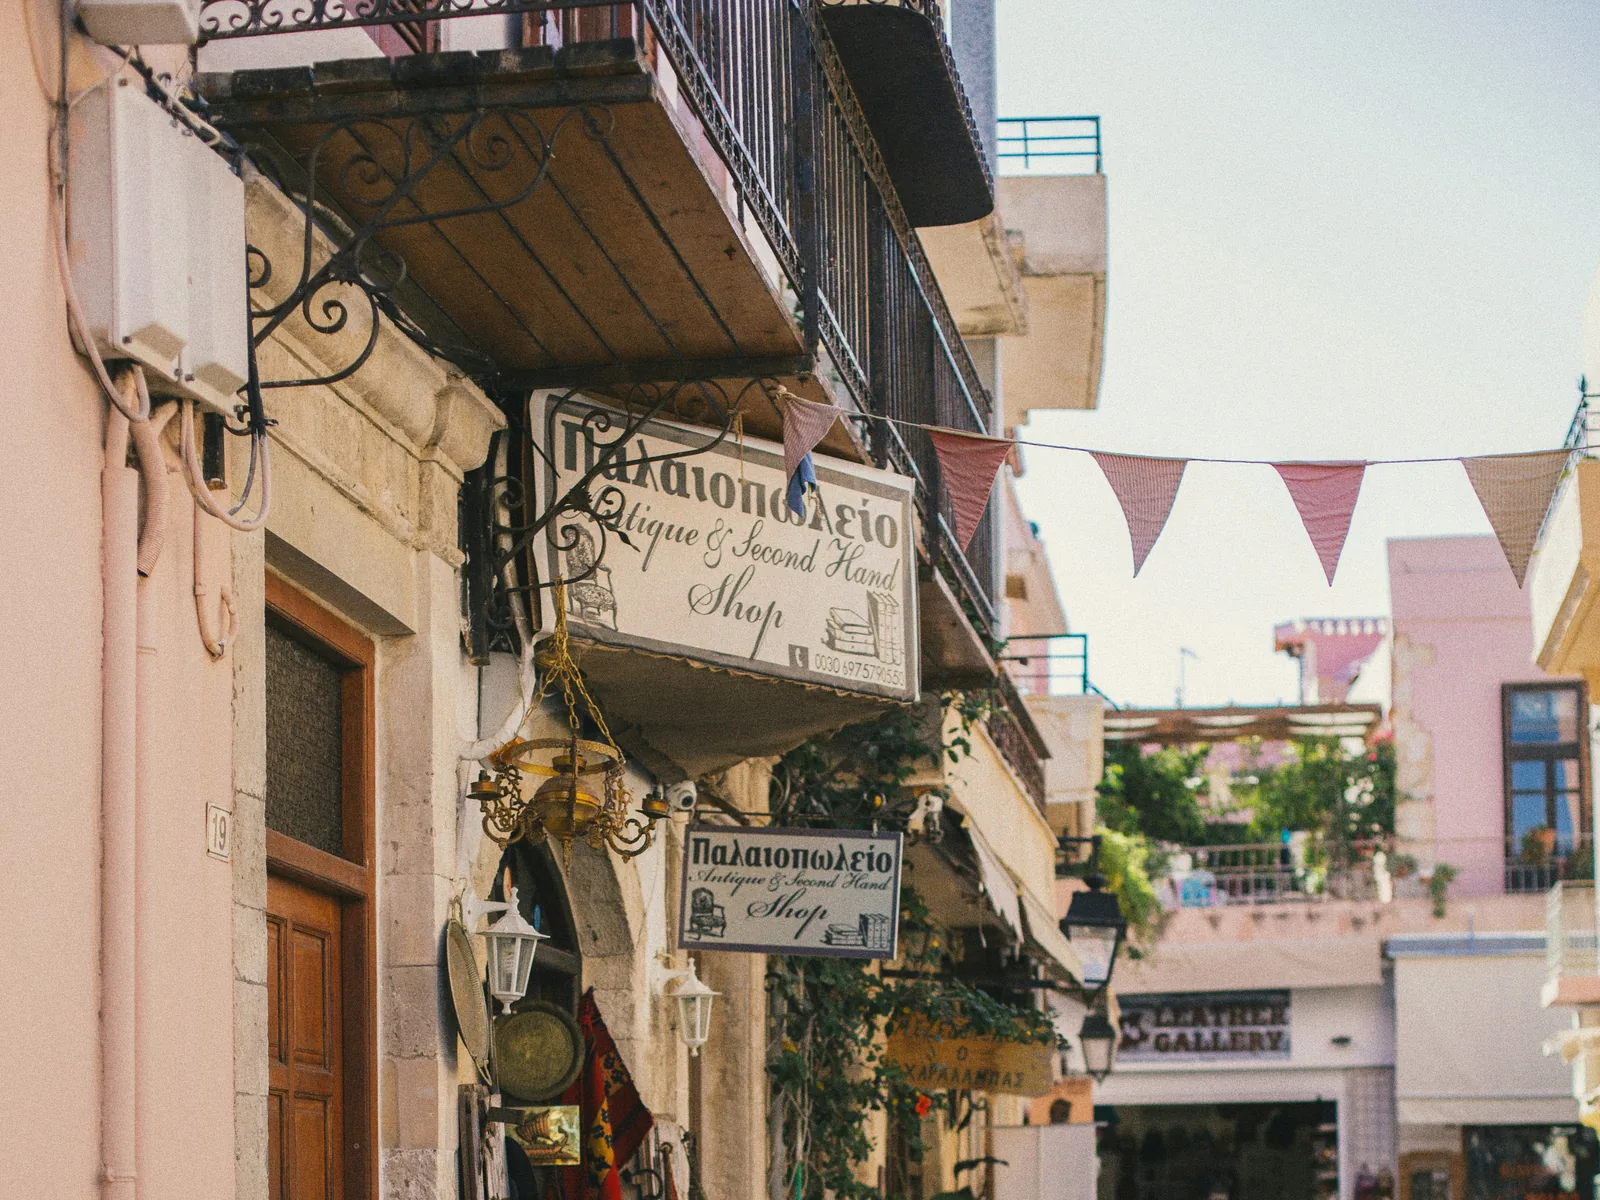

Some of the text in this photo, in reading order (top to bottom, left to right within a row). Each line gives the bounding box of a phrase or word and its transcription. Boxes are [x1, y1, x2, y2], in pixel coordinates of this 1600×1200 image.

[561, 419, 898, 549] Παλαιοπωλείο
[703, 517, 733, 569] &
[732, 519, 819, 572] Second
[825, 538, 901, 591] Hand
[688, 564, 783, 660] Shop
[815, 653, 840, 673] 0030
[212, 813, 227, 851] 19
[692, 838, 892, 873] Παλαιοπωλείο
[688, 867, 893, 896] Antique & Second Hand
[744, 887, 829, 940] Shop
[1153, 1004, 1288, 1027] LEATHER
[1154, 1031, 1284, 1052] GALLERY
